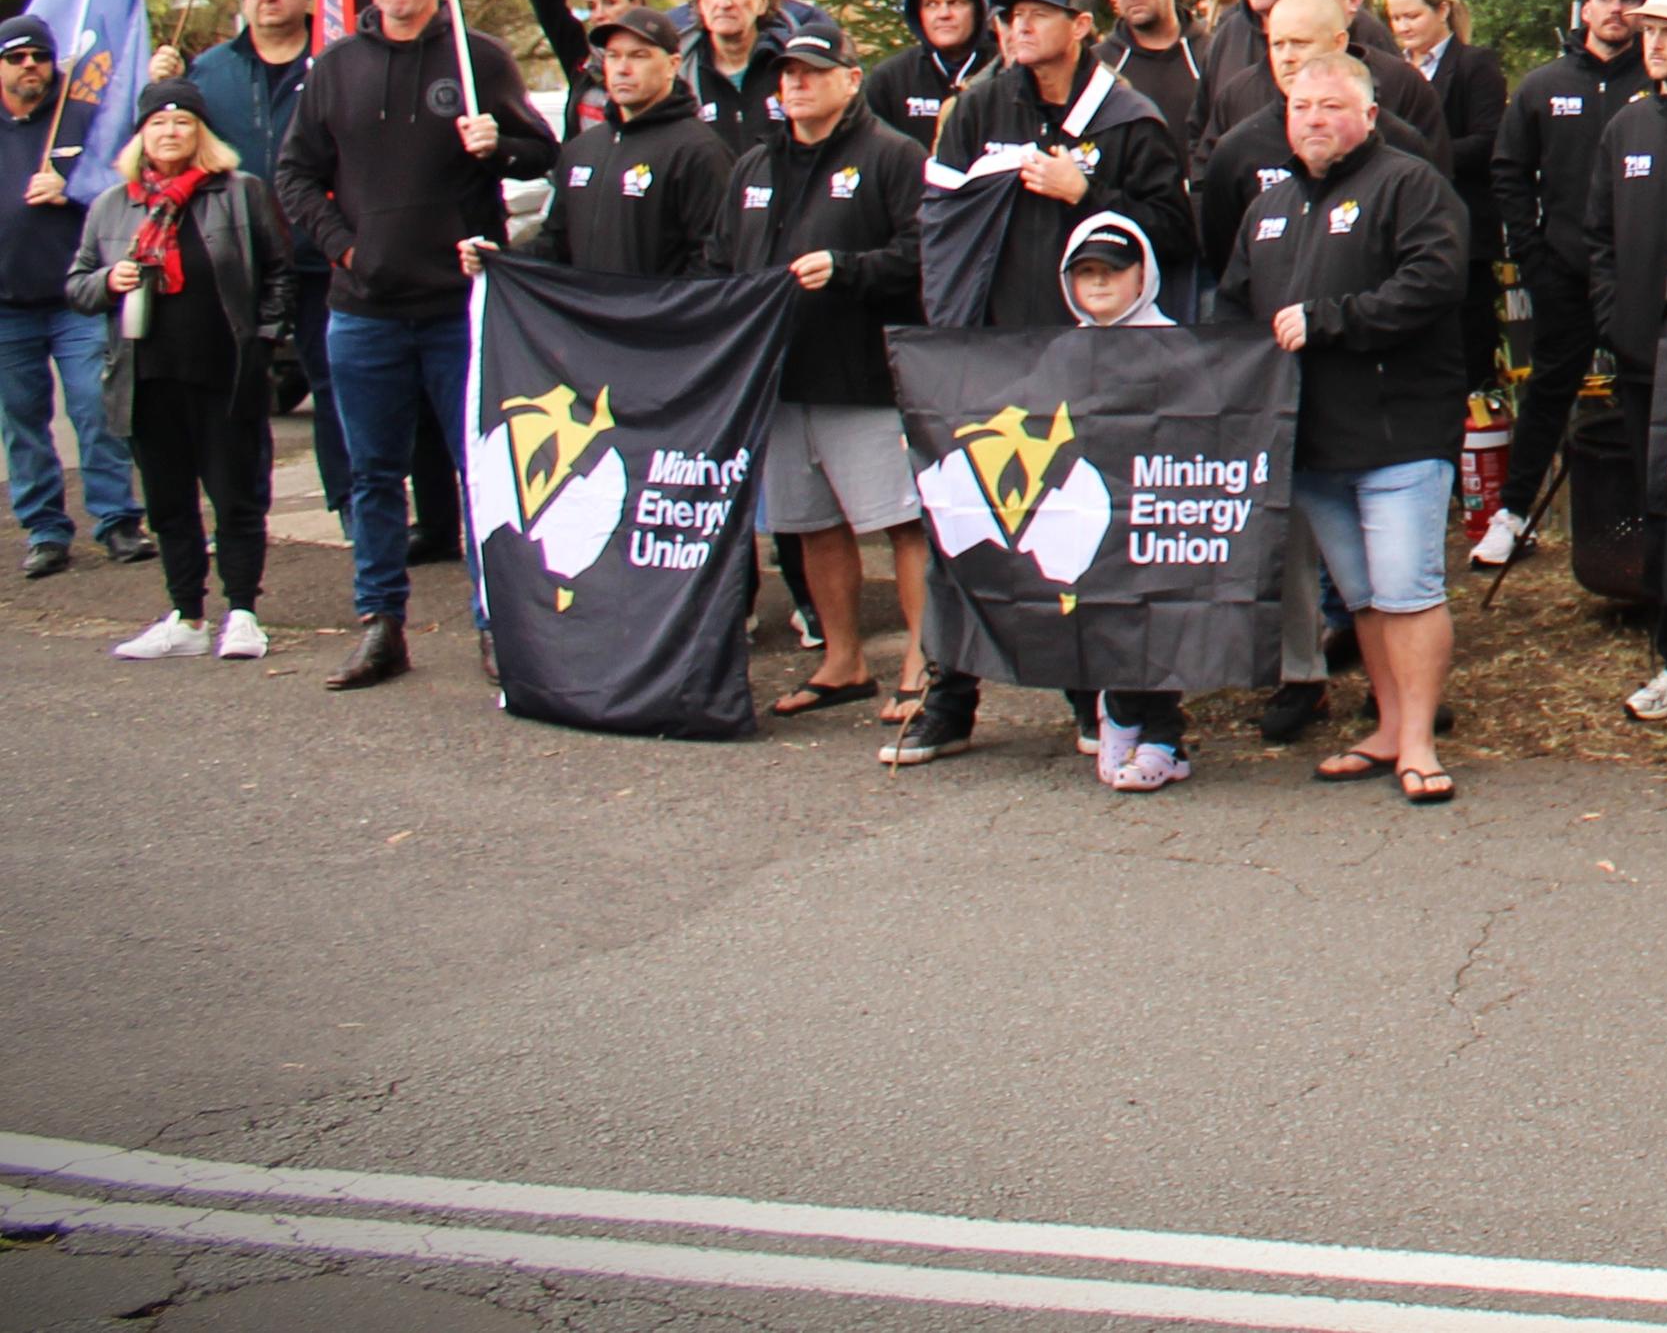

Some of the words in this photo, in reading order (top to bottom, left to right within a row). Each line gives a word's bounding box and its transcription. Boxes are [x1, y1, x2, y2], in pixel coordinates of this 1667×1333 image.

[1132, 454, 1248, 495] Mining
[1252, 450, 1269, 485] &
[635, 488, 733, 537] Energy
[1129, 492, 1252, 533] Energy
[629, 529, 711, 570] Union
[1128, 530, 1230, 565] Union
